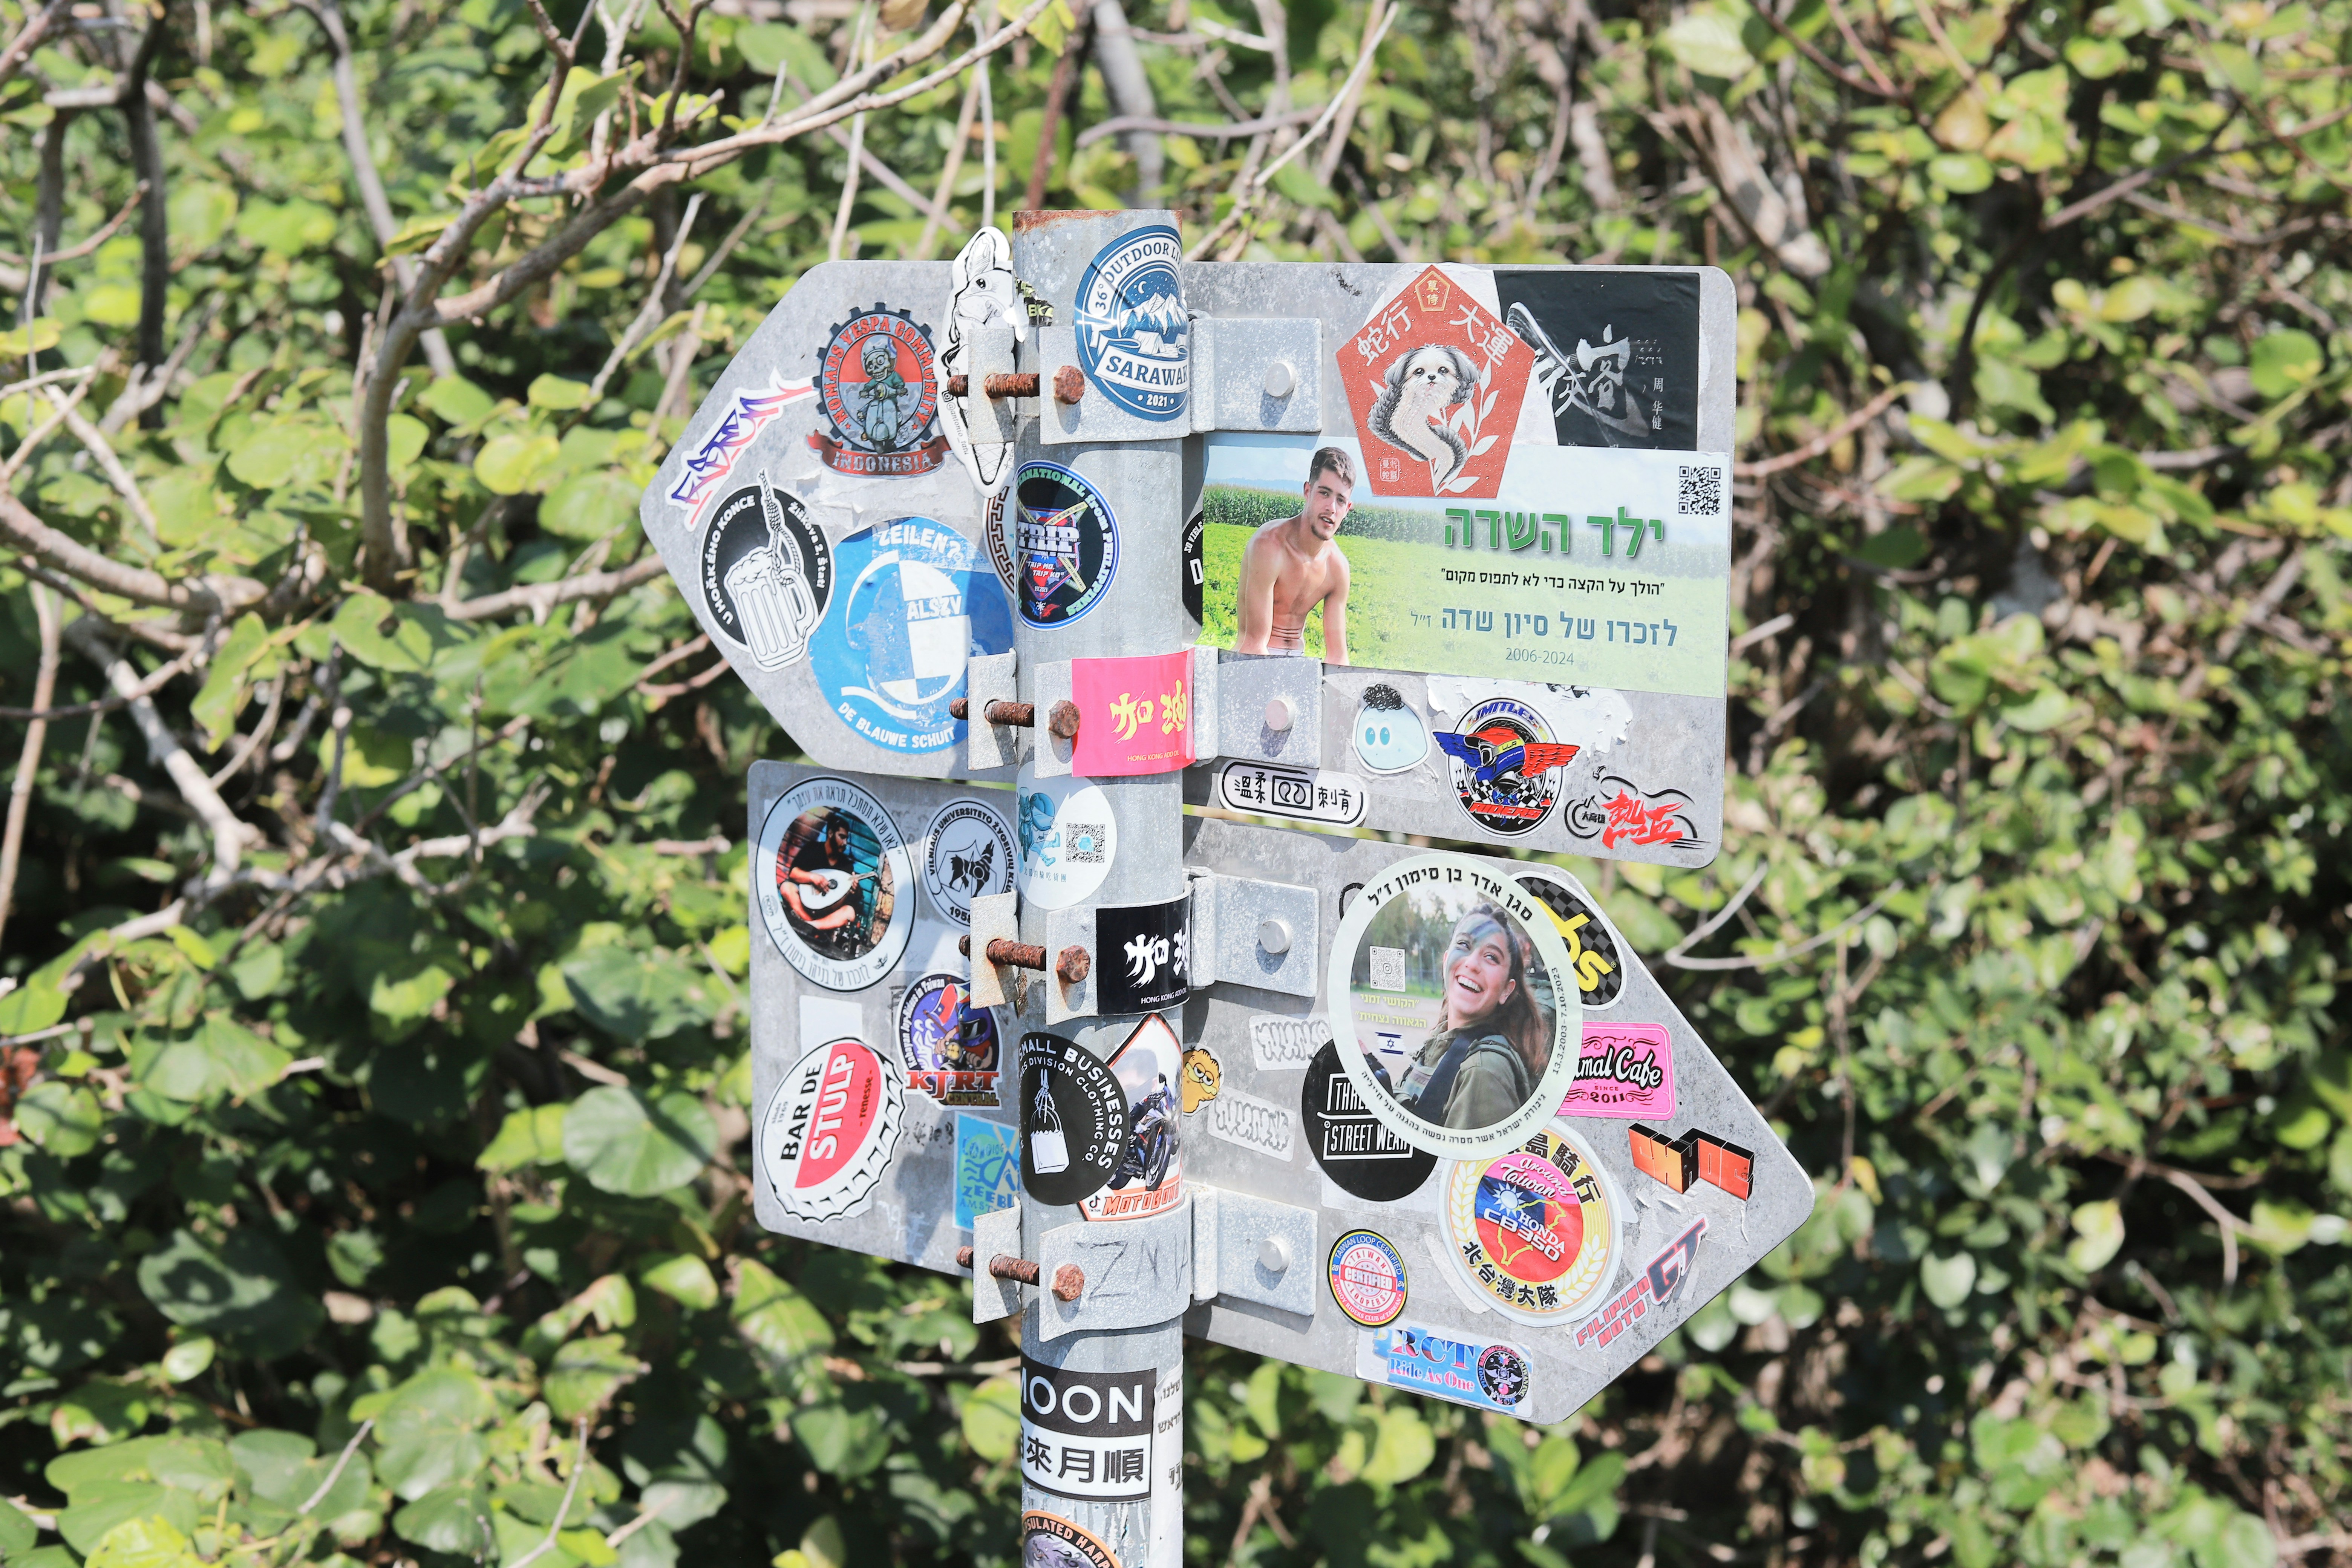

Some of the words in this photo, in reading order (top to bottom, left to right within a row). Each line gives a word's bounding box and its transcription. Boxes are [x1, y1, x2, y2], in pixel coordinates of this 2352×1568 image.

[1095, 283, 1107, 311] 36°
[1104, 242, 1169, 283] OUTDOOR
[824, 344, 849, 425] NOMADS
[839, 317, 890, 345] VESPA
[895, 320, 937, 426] COMMUNITY
[1146, 393, 1168, 408] 2021
[832, 450, 934, 473] INDONESIA
[717, 494, 756, 531] KONCE
[878, 524, 962, 559] ZEILEN?
[1443, 507, 1570, 554] השדה
[1586, 505, 1664, 558] ילד
[704, 530, 726, 614] HOŘKÉHO
[1066, 531, 1113, 616] PHILIPPINES
[1480, 572, 1519, 586] לתפוס
[1523, 573, 1540, 586] לא
[1544, 576, 1565, 589] כדי
[1568, 578, 1604, 593] הקצה
[1608, 578, 1626, 594] על
[722, 611, 734, 626] U
[1442, 607, 1493, 632] שדה
[1504, 612, 1549, 639] סיון
[1559, 611, 1595, 641] של
[1608, 618, 1678, 647] לזכרו
[1505, 647, 1575, 666] 2006-2024
[838, 701, 858, 721] DE
[855, 717, 907, 747] BLAUWE
[911, 726, 956, 749] SCHUIT
[1127, 754, 1146, 763] HONG
[1147, 753, 1163, 761] KONG
[813, 786, 824, 801] את
[1468, 802, 1544, 820] RIDERS
[929, 828, 943, 876] VILNIAUS
[938, 807, 992, 829] UNIVERSITETO
[1395, 867, 1439, 891] סימון
[1447, 868, 1462, 883] בן
[1471, 872, 1502, 897] אדר
[1505, 893, 1533, 922] סגן
[914, 988, 924, 998] in
[920, 978, 945, 993] Taiwan
[1141, 995, 1160, 1004] HONG
[1161, 991, 1174, 1001] KONG
[1392, 1015, 1427, 1028] הגאווה
[1615, 1049, 1661, 1087] Cafe
[906, 1070, 999, 1098] KJRT
[778, 1100, 789, 1123] 1969
[780, 1102, 812, 1160] BAR
[800, 1063, 822, 1096] DE
[809, 1053, 856, 1160] STULP
[946, 1092, 1000, 1106] CENTRAL
[1018, 1038, 1057, 1062] SMALL
[1063, 1046, 1124, 1170] BUSINESSES
[1028, 1056, 1074, 1077] DIVISION
[1075, 1076, 1105, 1141] CLOTHING
[1384, 1099, 1395, 1112] על
[1589, 1092, 1626, 1104] 2011
[1396, 1111, 1419, 1131] בהגנה
[1422, 1127, 1446, 1142] נפשה
[1496, 1118, 1522, 1137] ישראל
[1331, 1124, 1374, 1152] STREET
[1475, 1133, 1495, 1142] אשר
[1500, 1162, 1557, 1199] Taiwan
[1507, 1133, 1601, 1204] 島騎行
[1483, 1207, 1560, 1262] CB350
[1516, 1210, 1566, 1256] HONDA
[1334, 1237, 1357, 1259] TAIWAN
[1356, 1236, 1376, 1244] LOOP
[1376, 1240, 1403, 1275] CERTIFIED
[1350, 1250, 1386, 1269] TAIWAN
[1344, 1267, 1393, 1290] CERTIFIED
[1462, 1241, 1558, 1308] 北台灣大隊
[1335, 1282, 1347, 1305] PINOY
[1345, 1304, 1364, 1319] RIDERS
[1384, 1297, 1403, 1318] TAIWAN
[1350, 1289, 1386, 1307] LOOPERS
[1576, 1277, 1650, 1348] FILIPINO
[1597, 1299, 1646, 1349] MOTO
[1389, 1358, 1423, 1380] Ride
[1423, 1366, 1443, 1384] As
[1444, 1371, 1475, 1392] One
[1021, 1426, 1144, 1484] 來月順
